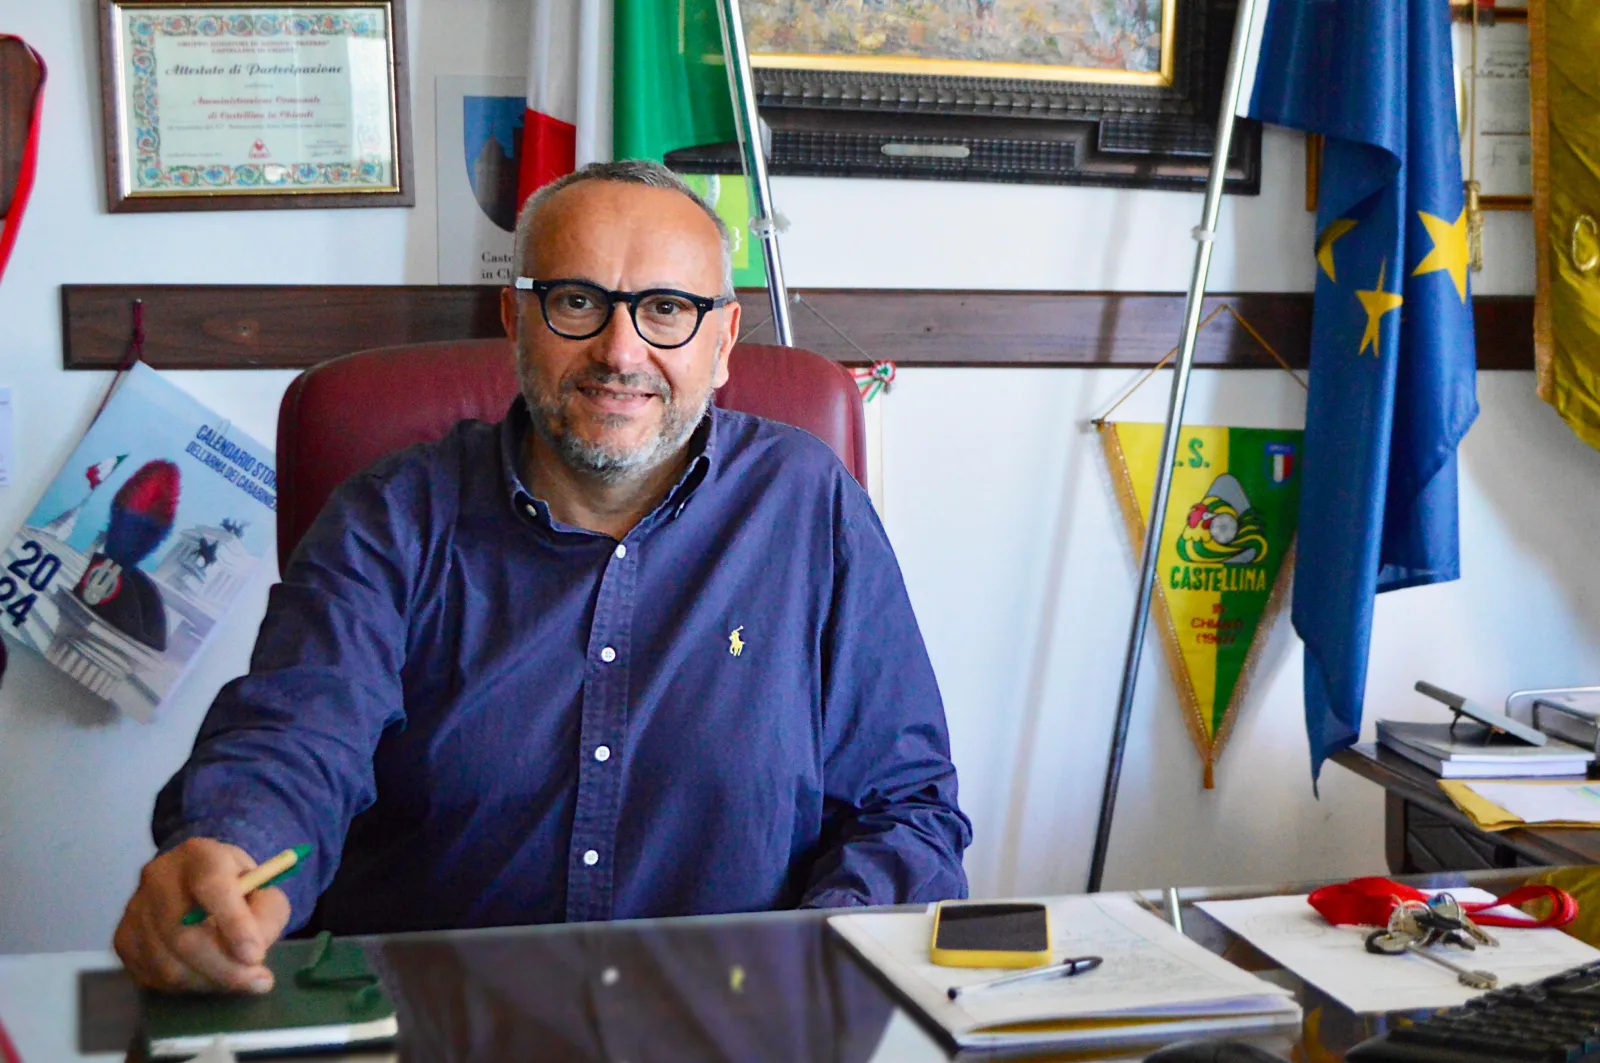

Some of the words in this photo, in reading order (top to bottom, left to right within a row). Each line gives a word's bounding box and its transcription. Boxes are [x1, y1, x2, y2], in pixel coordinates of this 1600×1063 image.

[165, 63, 225, 76] Attestato
[229, 63, 242, 76] di
[246, 63, 343, 77] Partecipazione
[481, 251, 513, 264] Caste
[481, 268, 494, 280] in
[196, 424, 256, 472] CALENDARIO
[251, 462, 277, 492] STOR
[185, 441, 227, 474] DELL'ARMA
[223, 466, 240, 484] DEI
[236, 475, 277, 513] CARABINIE
[7, 540, 62, 591] 20
[1169, 565, 1267, 592] CASTELLINA
